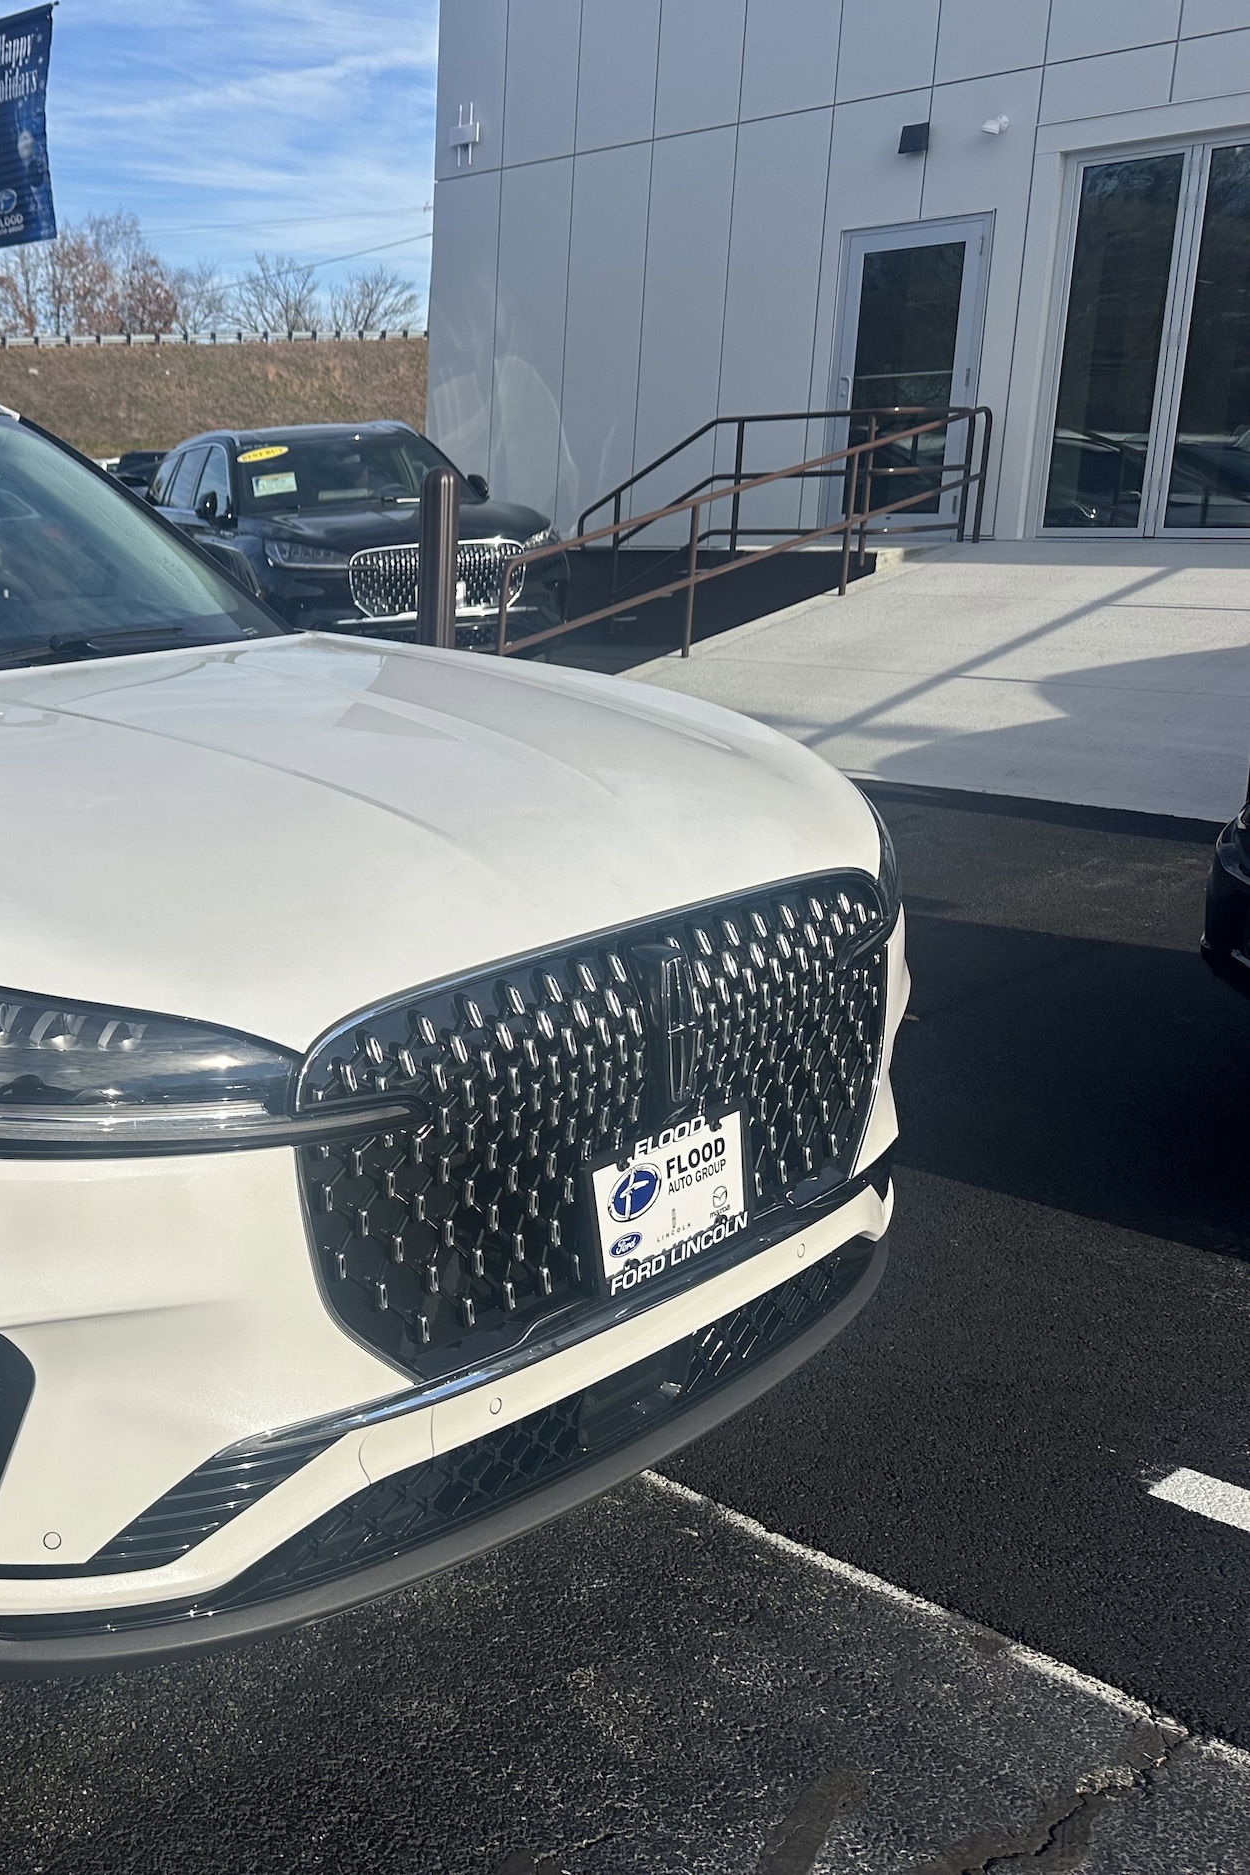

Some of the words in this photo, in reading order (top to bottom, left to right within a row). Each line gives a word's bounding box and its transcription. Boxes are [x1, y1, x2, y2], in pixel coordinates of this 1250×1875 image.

[634, 1115, 706, 1159] FLOOD
[666, 1137, 726, 1179] FLOOD
[668, 1175, 693, 1195] AUTO
[695, 1158, 726, 1182] GROUP
[615, 1236, 638, 1255] Ford
[657, 1222, 692, 1243] LINCOLN
[611, 1255, 666, 1296] FORD
[670, 1211, 748, 1266] LINCOLN
